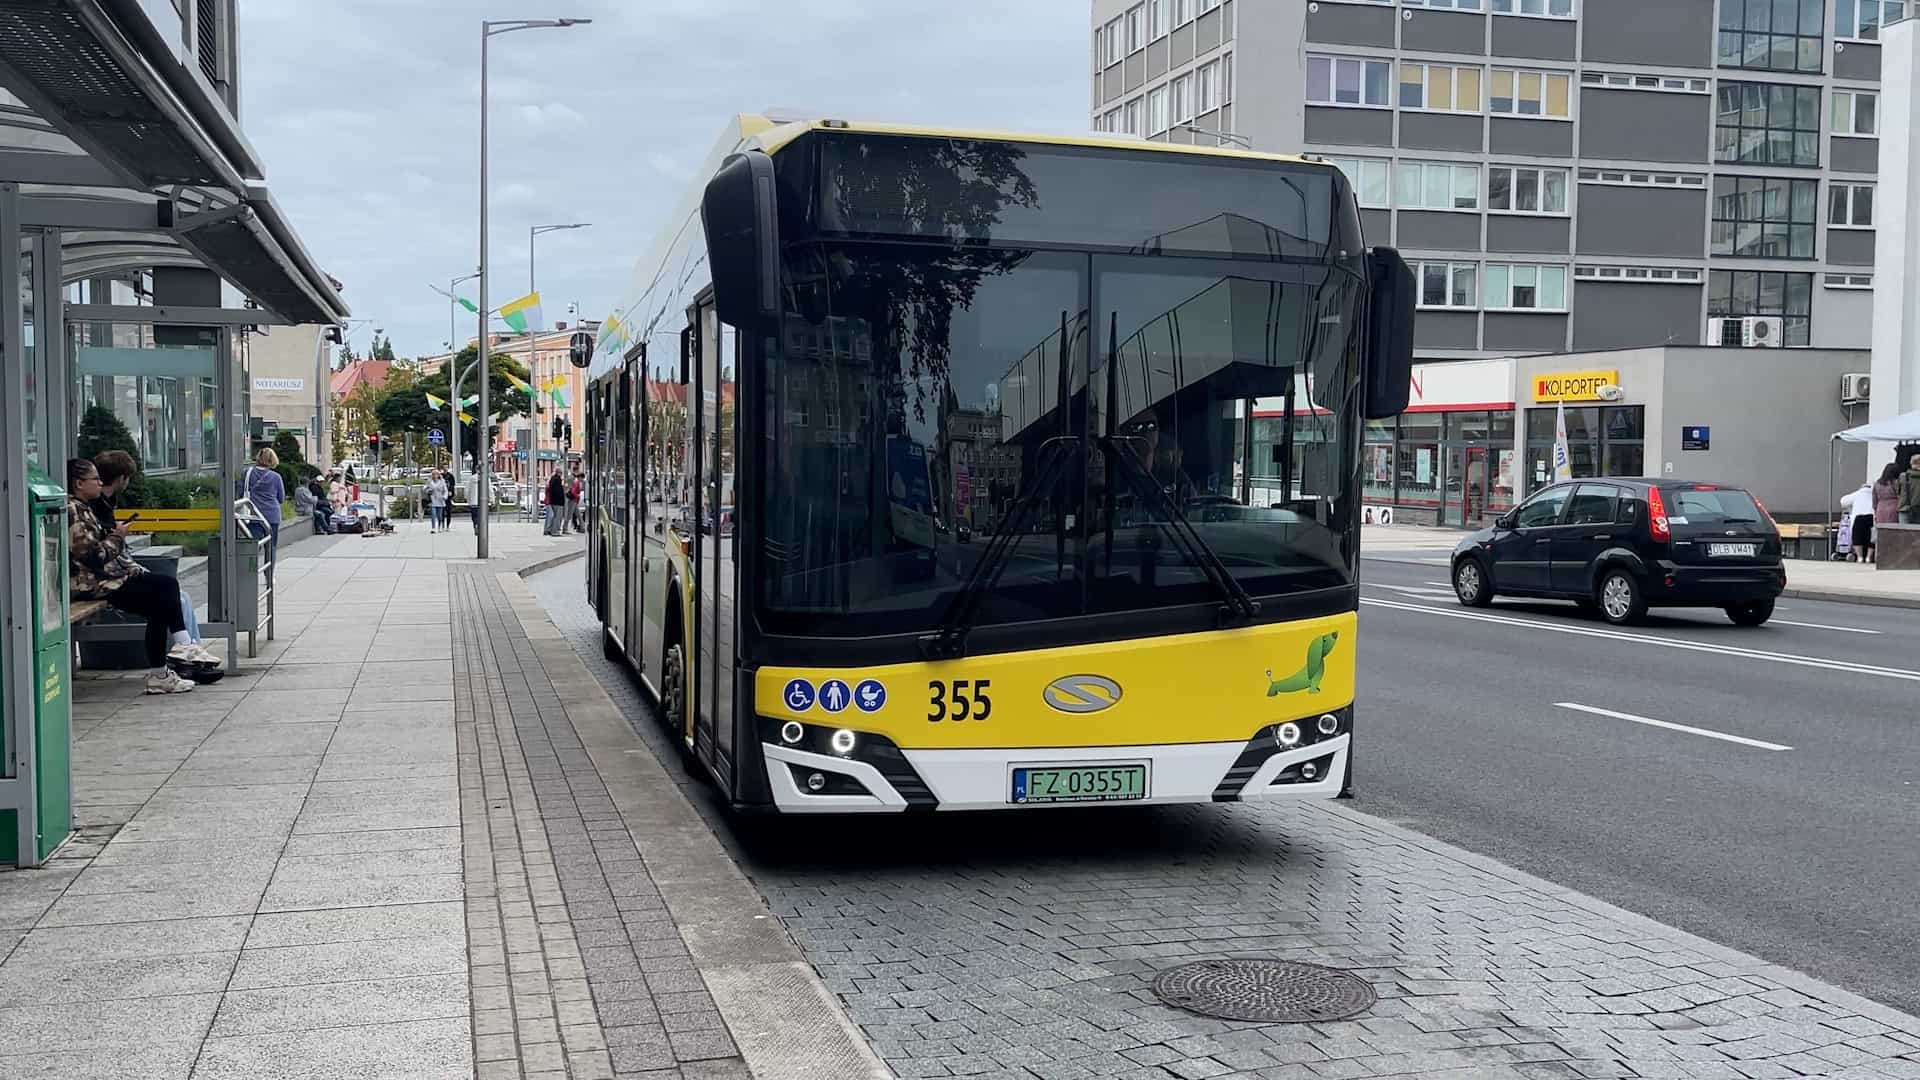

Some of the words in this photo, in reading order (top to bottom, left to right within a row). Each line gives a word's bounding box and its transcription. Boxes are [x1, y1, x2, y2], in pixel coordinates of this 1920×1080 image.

[927, 680, 991, 722] 355
[1030, 772, 1060, 795] FZ
[1069, 769, 1138, 793] 0355T
